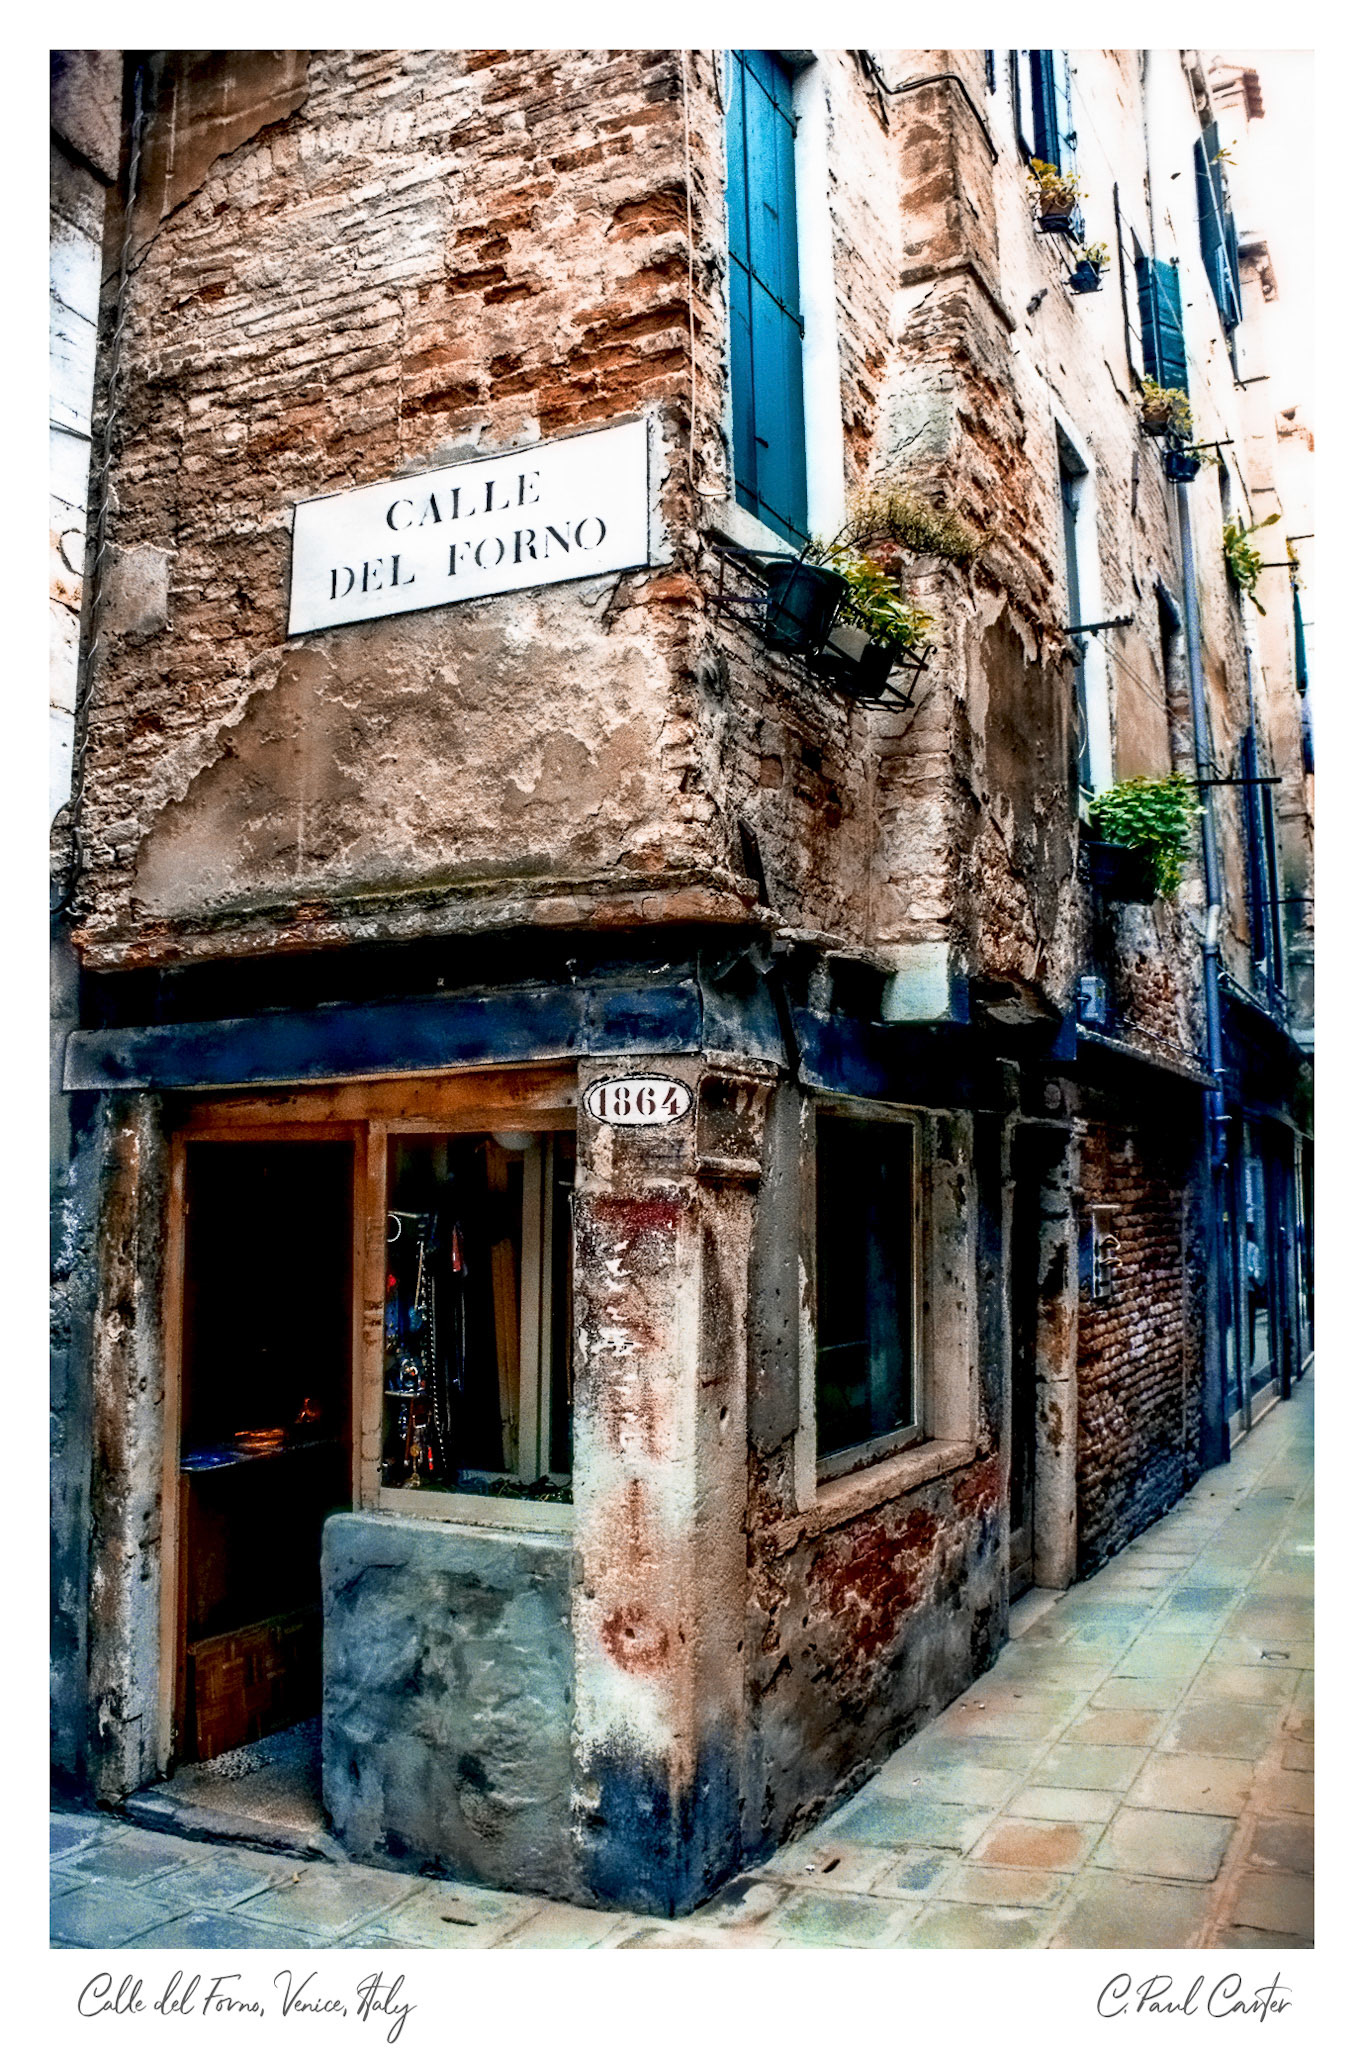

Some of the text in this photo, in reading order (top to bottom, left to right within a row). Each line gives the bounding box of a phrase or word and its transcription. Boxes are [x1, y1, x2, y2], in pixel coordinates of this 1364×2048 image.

[386, 471, 541, 531] CALLE
[330, 516, 607, 600] DEL FORNO
[598, 1086, 681, 1117] 1864
